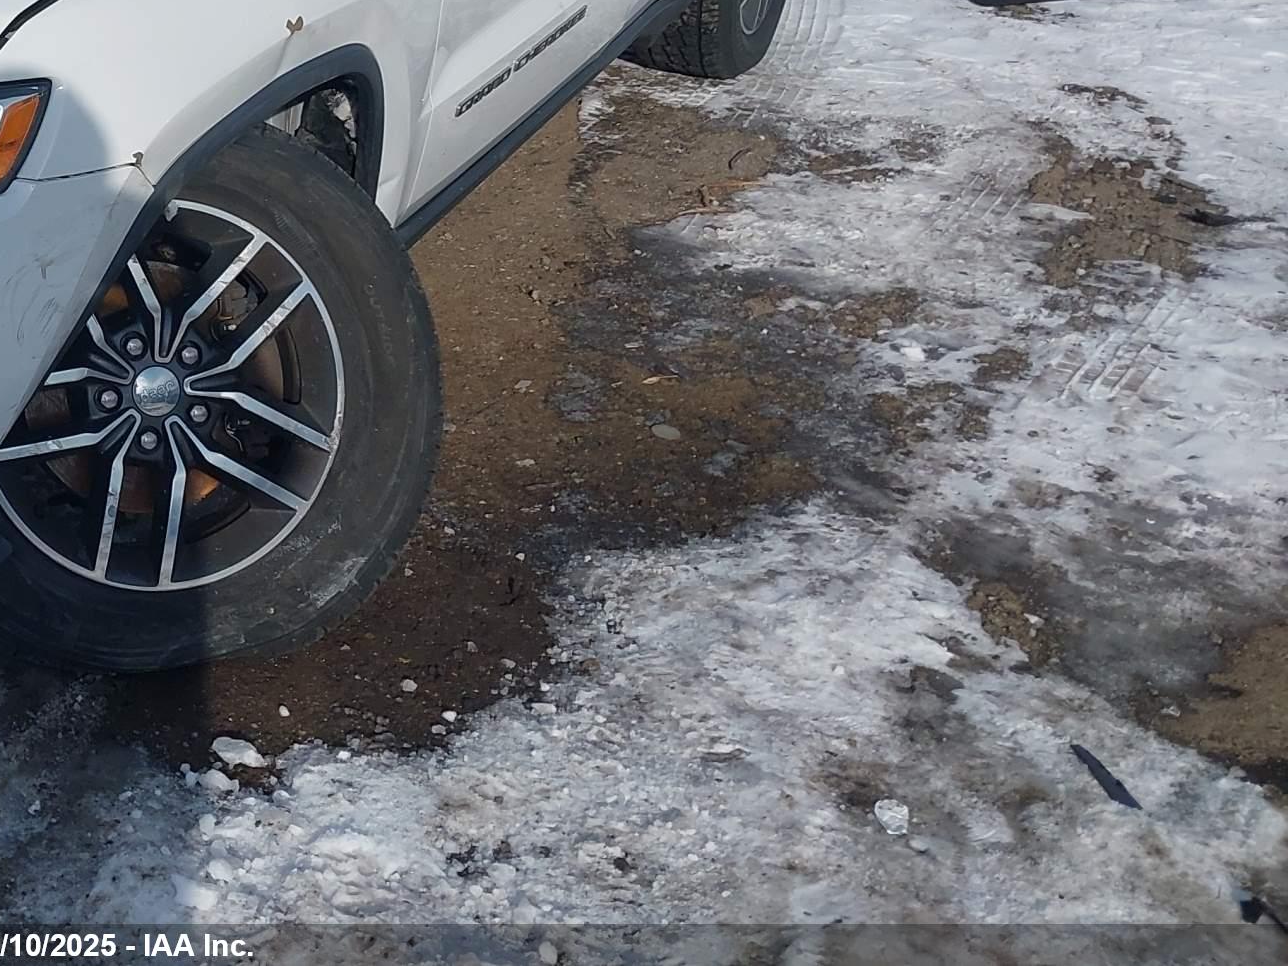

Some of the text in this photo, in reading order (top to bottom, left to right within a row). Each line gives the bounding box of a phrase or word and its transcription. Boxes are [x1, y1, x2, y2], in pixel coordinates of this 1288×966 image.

[454, 4, 588, 117] GRAND CHEROKEE
[141, 380, 175, 402] Jeep
